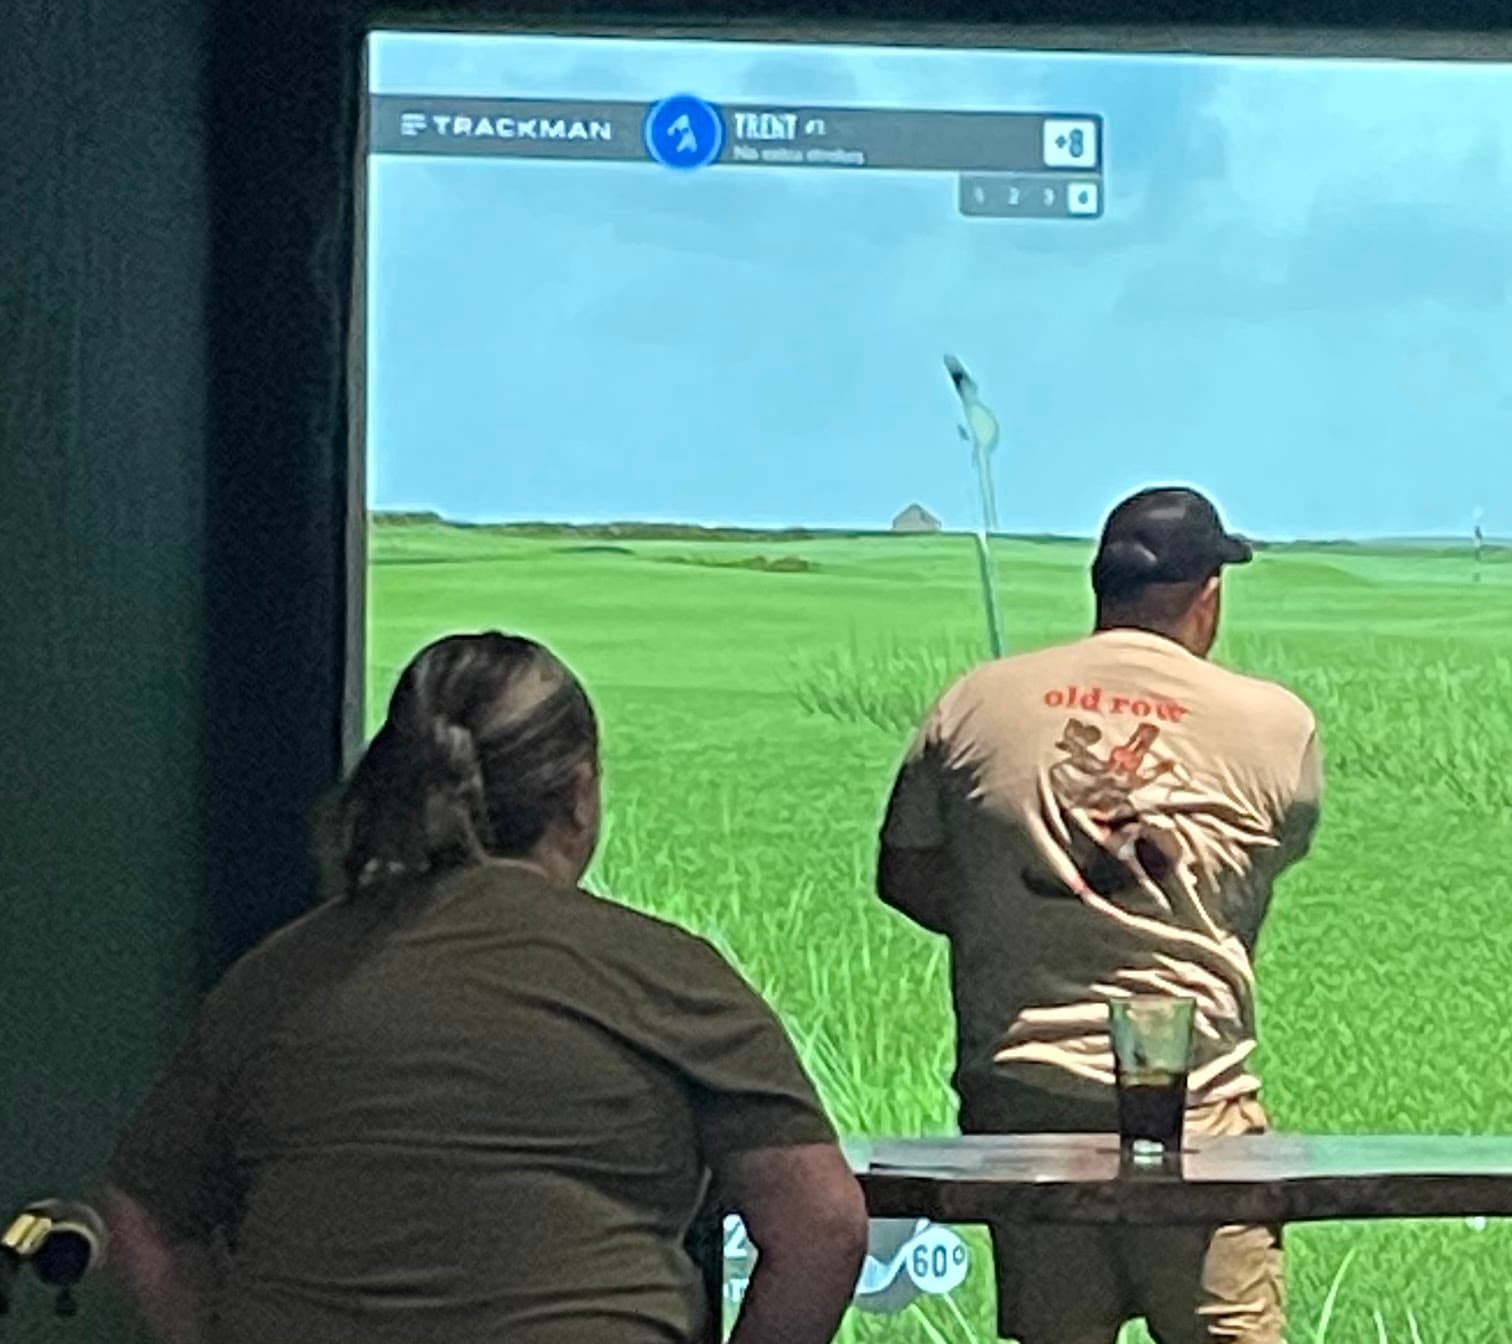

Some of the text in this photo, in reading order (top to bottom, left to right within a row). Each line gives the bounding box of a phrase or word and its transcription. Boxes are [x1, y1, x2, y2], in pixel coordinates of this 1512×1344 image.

[432, 116, 611, 140] TRACKMAN
[1008, 187, 1020, 205] 2
[1044, 686, 1189, 723] old row
